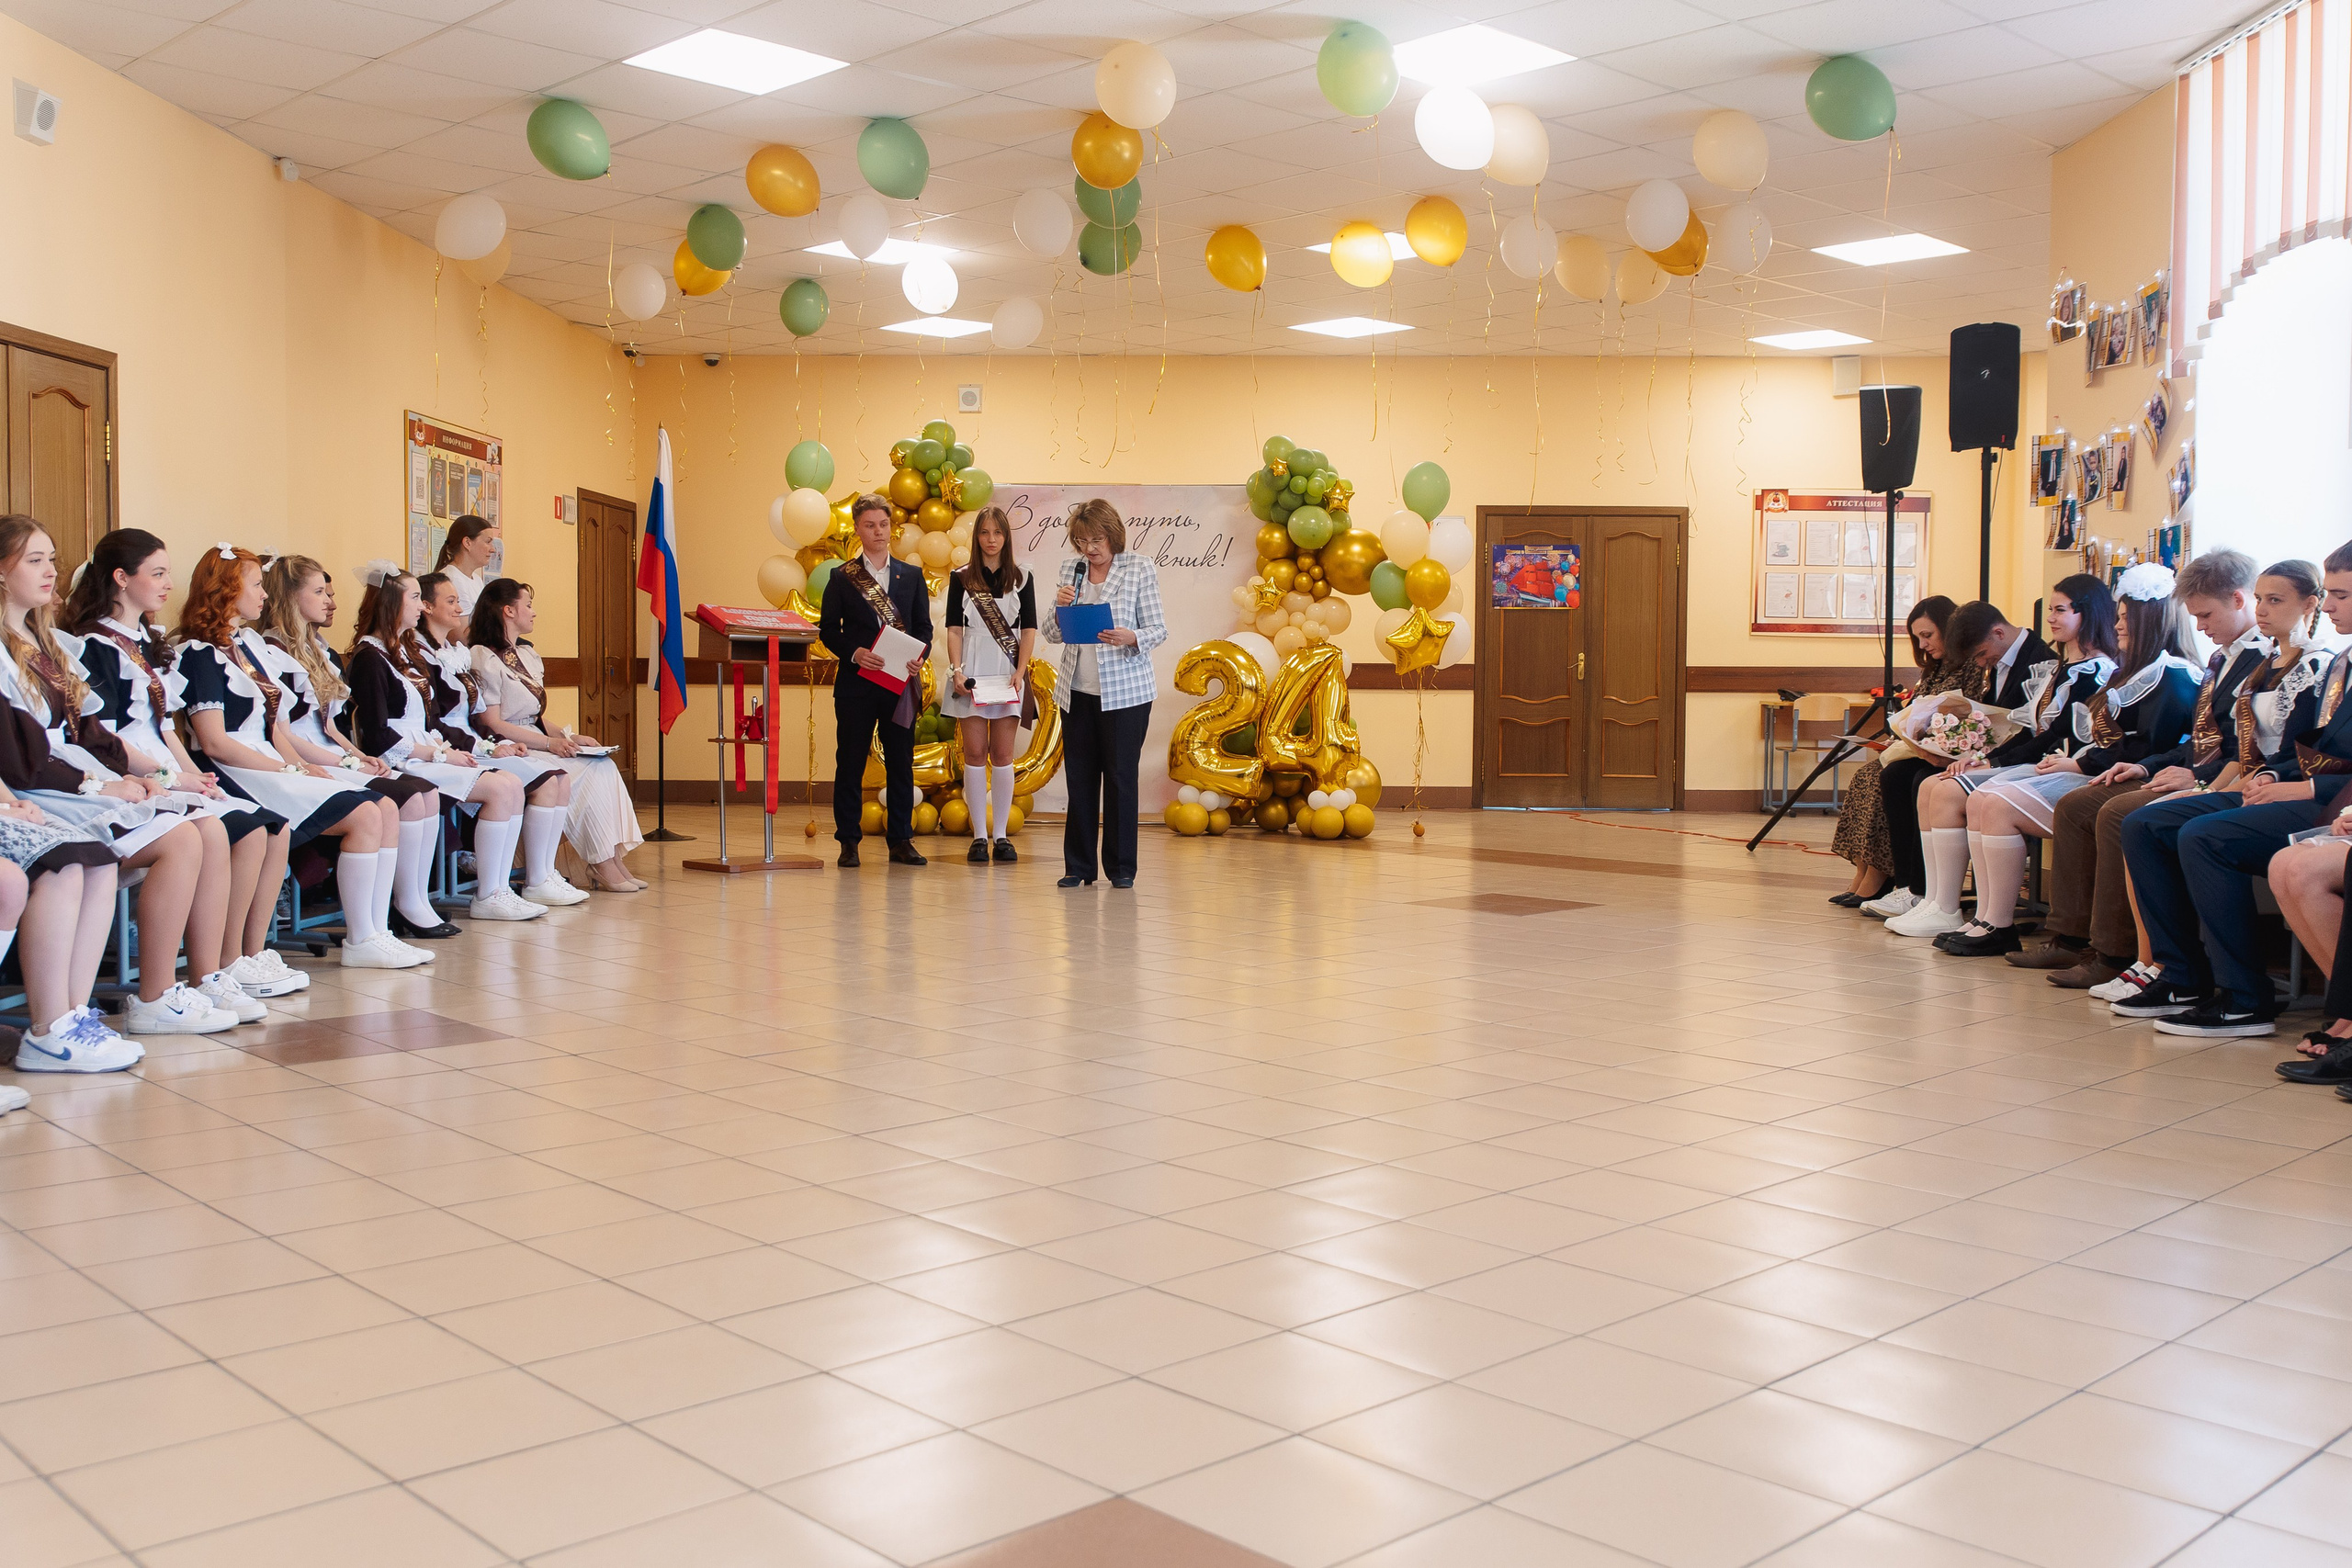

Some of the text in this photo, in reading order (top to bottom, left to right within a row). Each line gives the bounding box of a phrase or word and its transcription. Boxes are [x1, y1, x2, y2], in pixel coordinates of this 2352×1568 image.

[442, 434, 472, 450] ИНФОРМАЦИЯ
[1005, 494, 1034, 530] В
[1826, 500, 1883, 508] АТТЕСТАЦИЯ
[1168, 639, 1362, 799] 24
